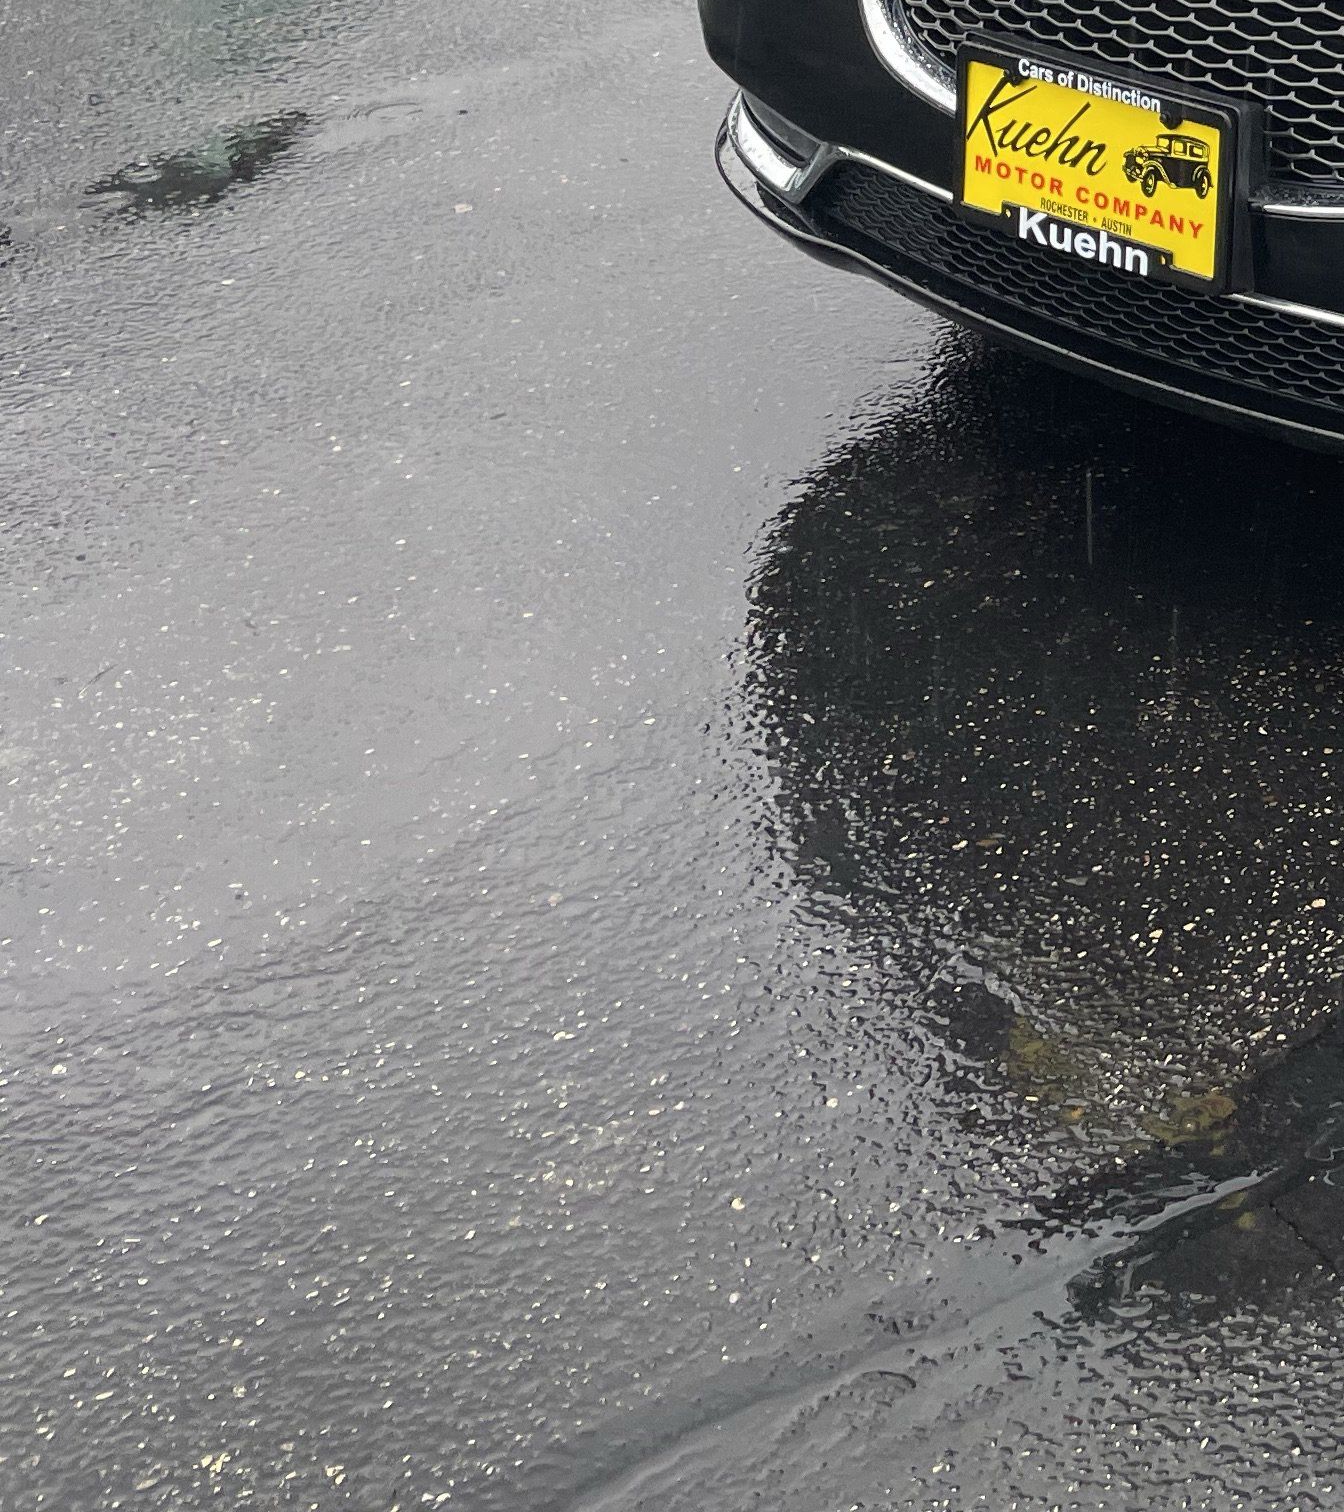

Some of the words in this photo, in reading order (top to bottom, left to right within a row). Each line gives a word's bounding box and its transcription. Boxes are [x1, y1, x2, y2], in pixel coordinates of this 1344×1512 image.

[1018, 58, 1054, 83] Cars
[1057, 71, 1074, 88] of
[1077, 74, 1161, 113] Distinction
[966, 74, 1108, 177] Kuehn
[975, 155, 1063, 197] MOTOR
[1075, 186, 1204, 239] COMPANY
[1040, 197, 1088, 223] ROCHESTER
[1101, 216, 1132, 237] AUSTIN
[1018, 206, 1149, 277] Kuehn
